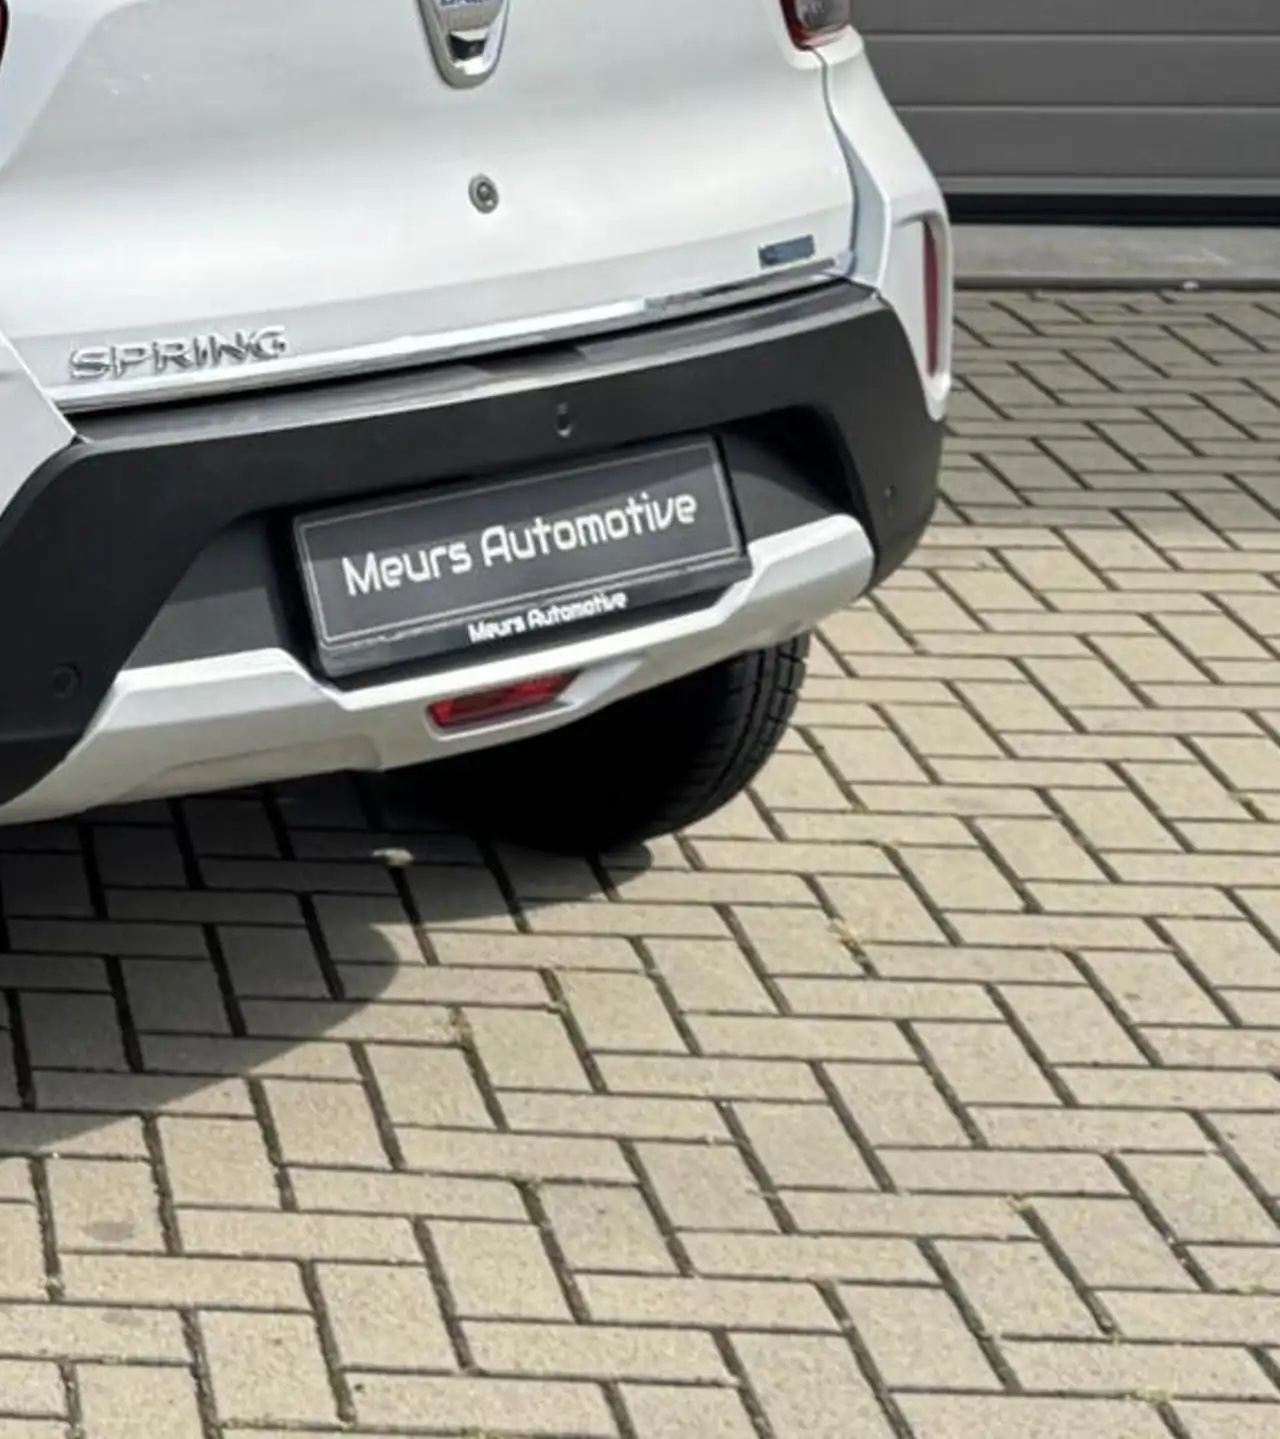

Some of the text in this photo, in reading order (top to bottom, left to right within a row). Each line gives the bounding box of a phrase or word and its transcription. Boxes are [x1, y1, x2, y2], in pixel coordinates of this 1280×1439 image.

[69, 324, 289, 381] SPRING
[342, 491, 698, 597] Meurs Automotive
[467, 591, 629, 644] Meurs Automotive
